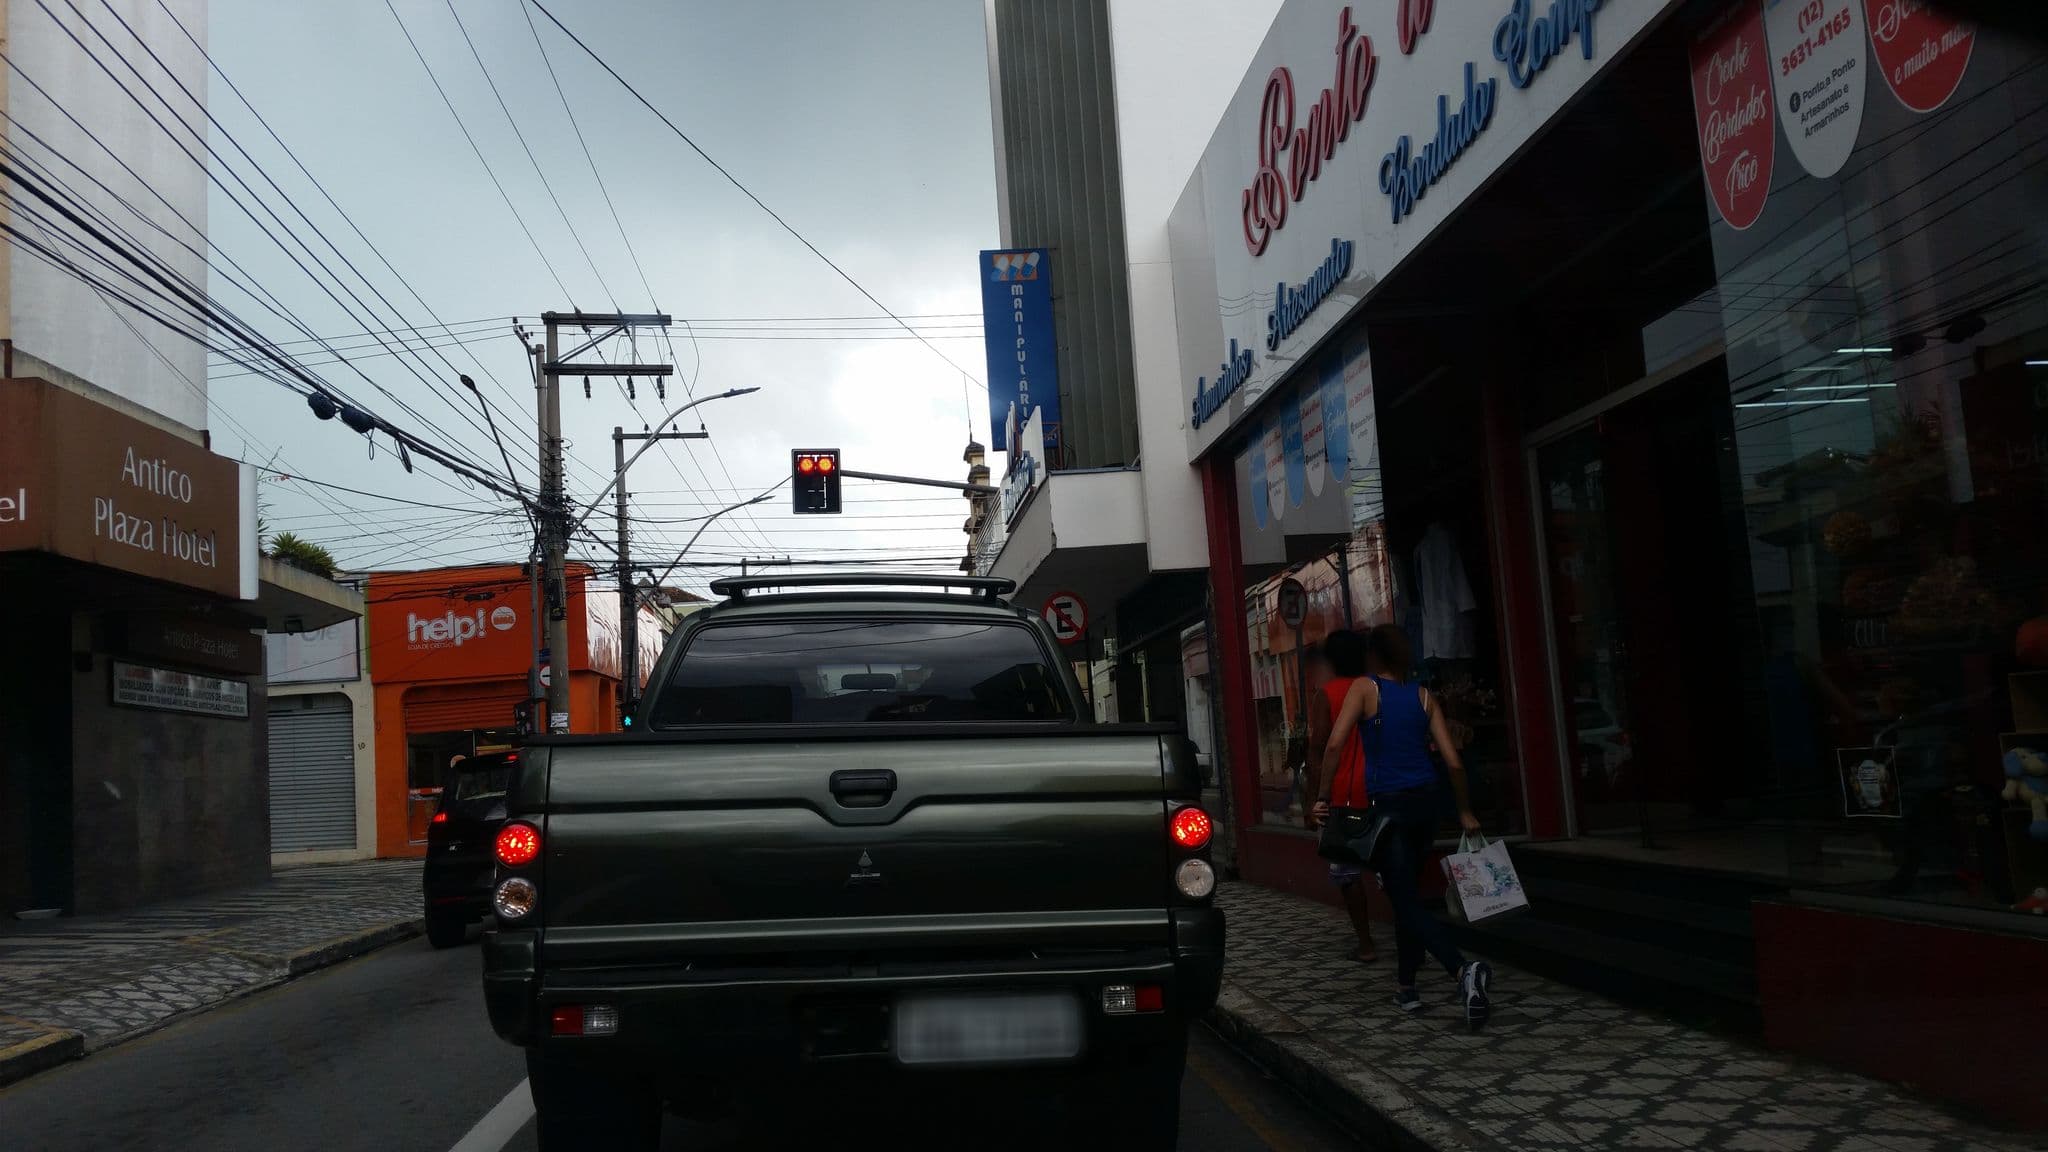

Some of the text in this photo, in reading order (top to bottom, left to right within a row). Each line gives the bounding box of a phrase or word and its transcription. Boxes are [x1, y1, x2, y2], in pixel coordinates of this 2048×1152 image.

[1798, 0, 1825, 34] (12)
[1780, 7, 1852, 77] 3631-4165
[1904, 38, 1937, 79] muito
[1802, 85, 1826, 104] Ponto
[1832, 58, 1856, 80] Ponto
[1704, 84, 1767, 164] Bordados
[1800, 89, 1844, 125] Artesanato
[1804, 102, 1850, 139] Armarinhos
[1378, 62, 1495, 224] Bordado
[122, 446, 192, 504] Antico
[94, 496, 216, 568] Plaza Hotel
[407, 607, 487, 647] help!
